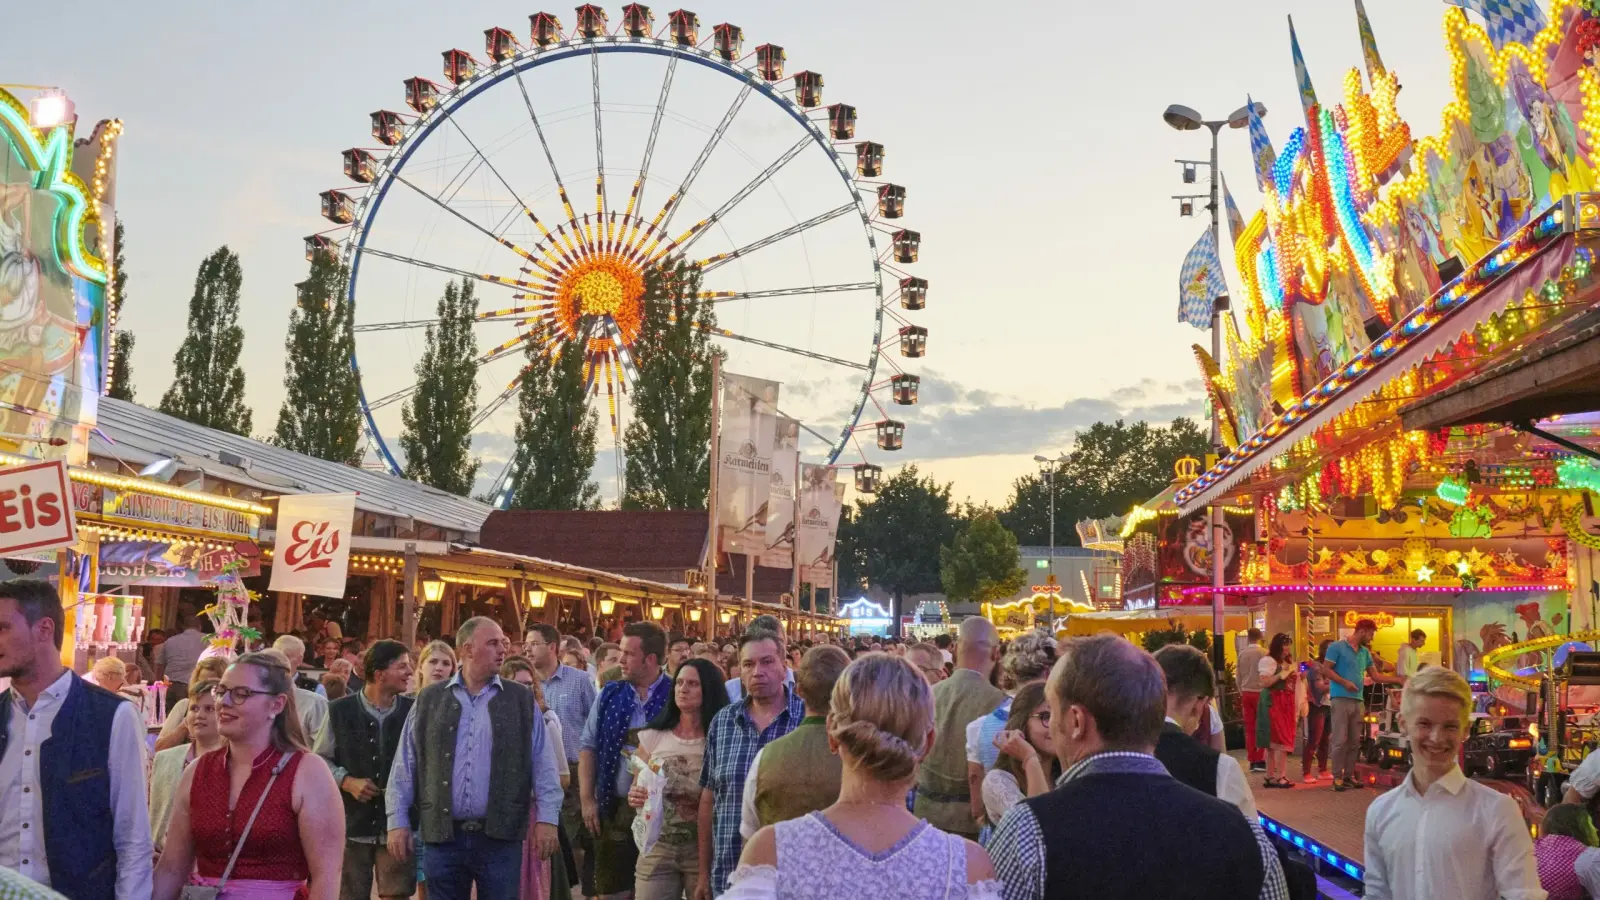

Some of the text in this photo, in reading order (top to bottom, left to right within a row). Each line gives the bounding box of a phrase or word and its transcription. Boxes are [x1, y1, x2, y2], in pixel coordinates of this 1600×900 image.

[0, 484, 61, 534] Eis
[284, 520, 340, 566] Eis
[853, 606, 873, 617] EIS
